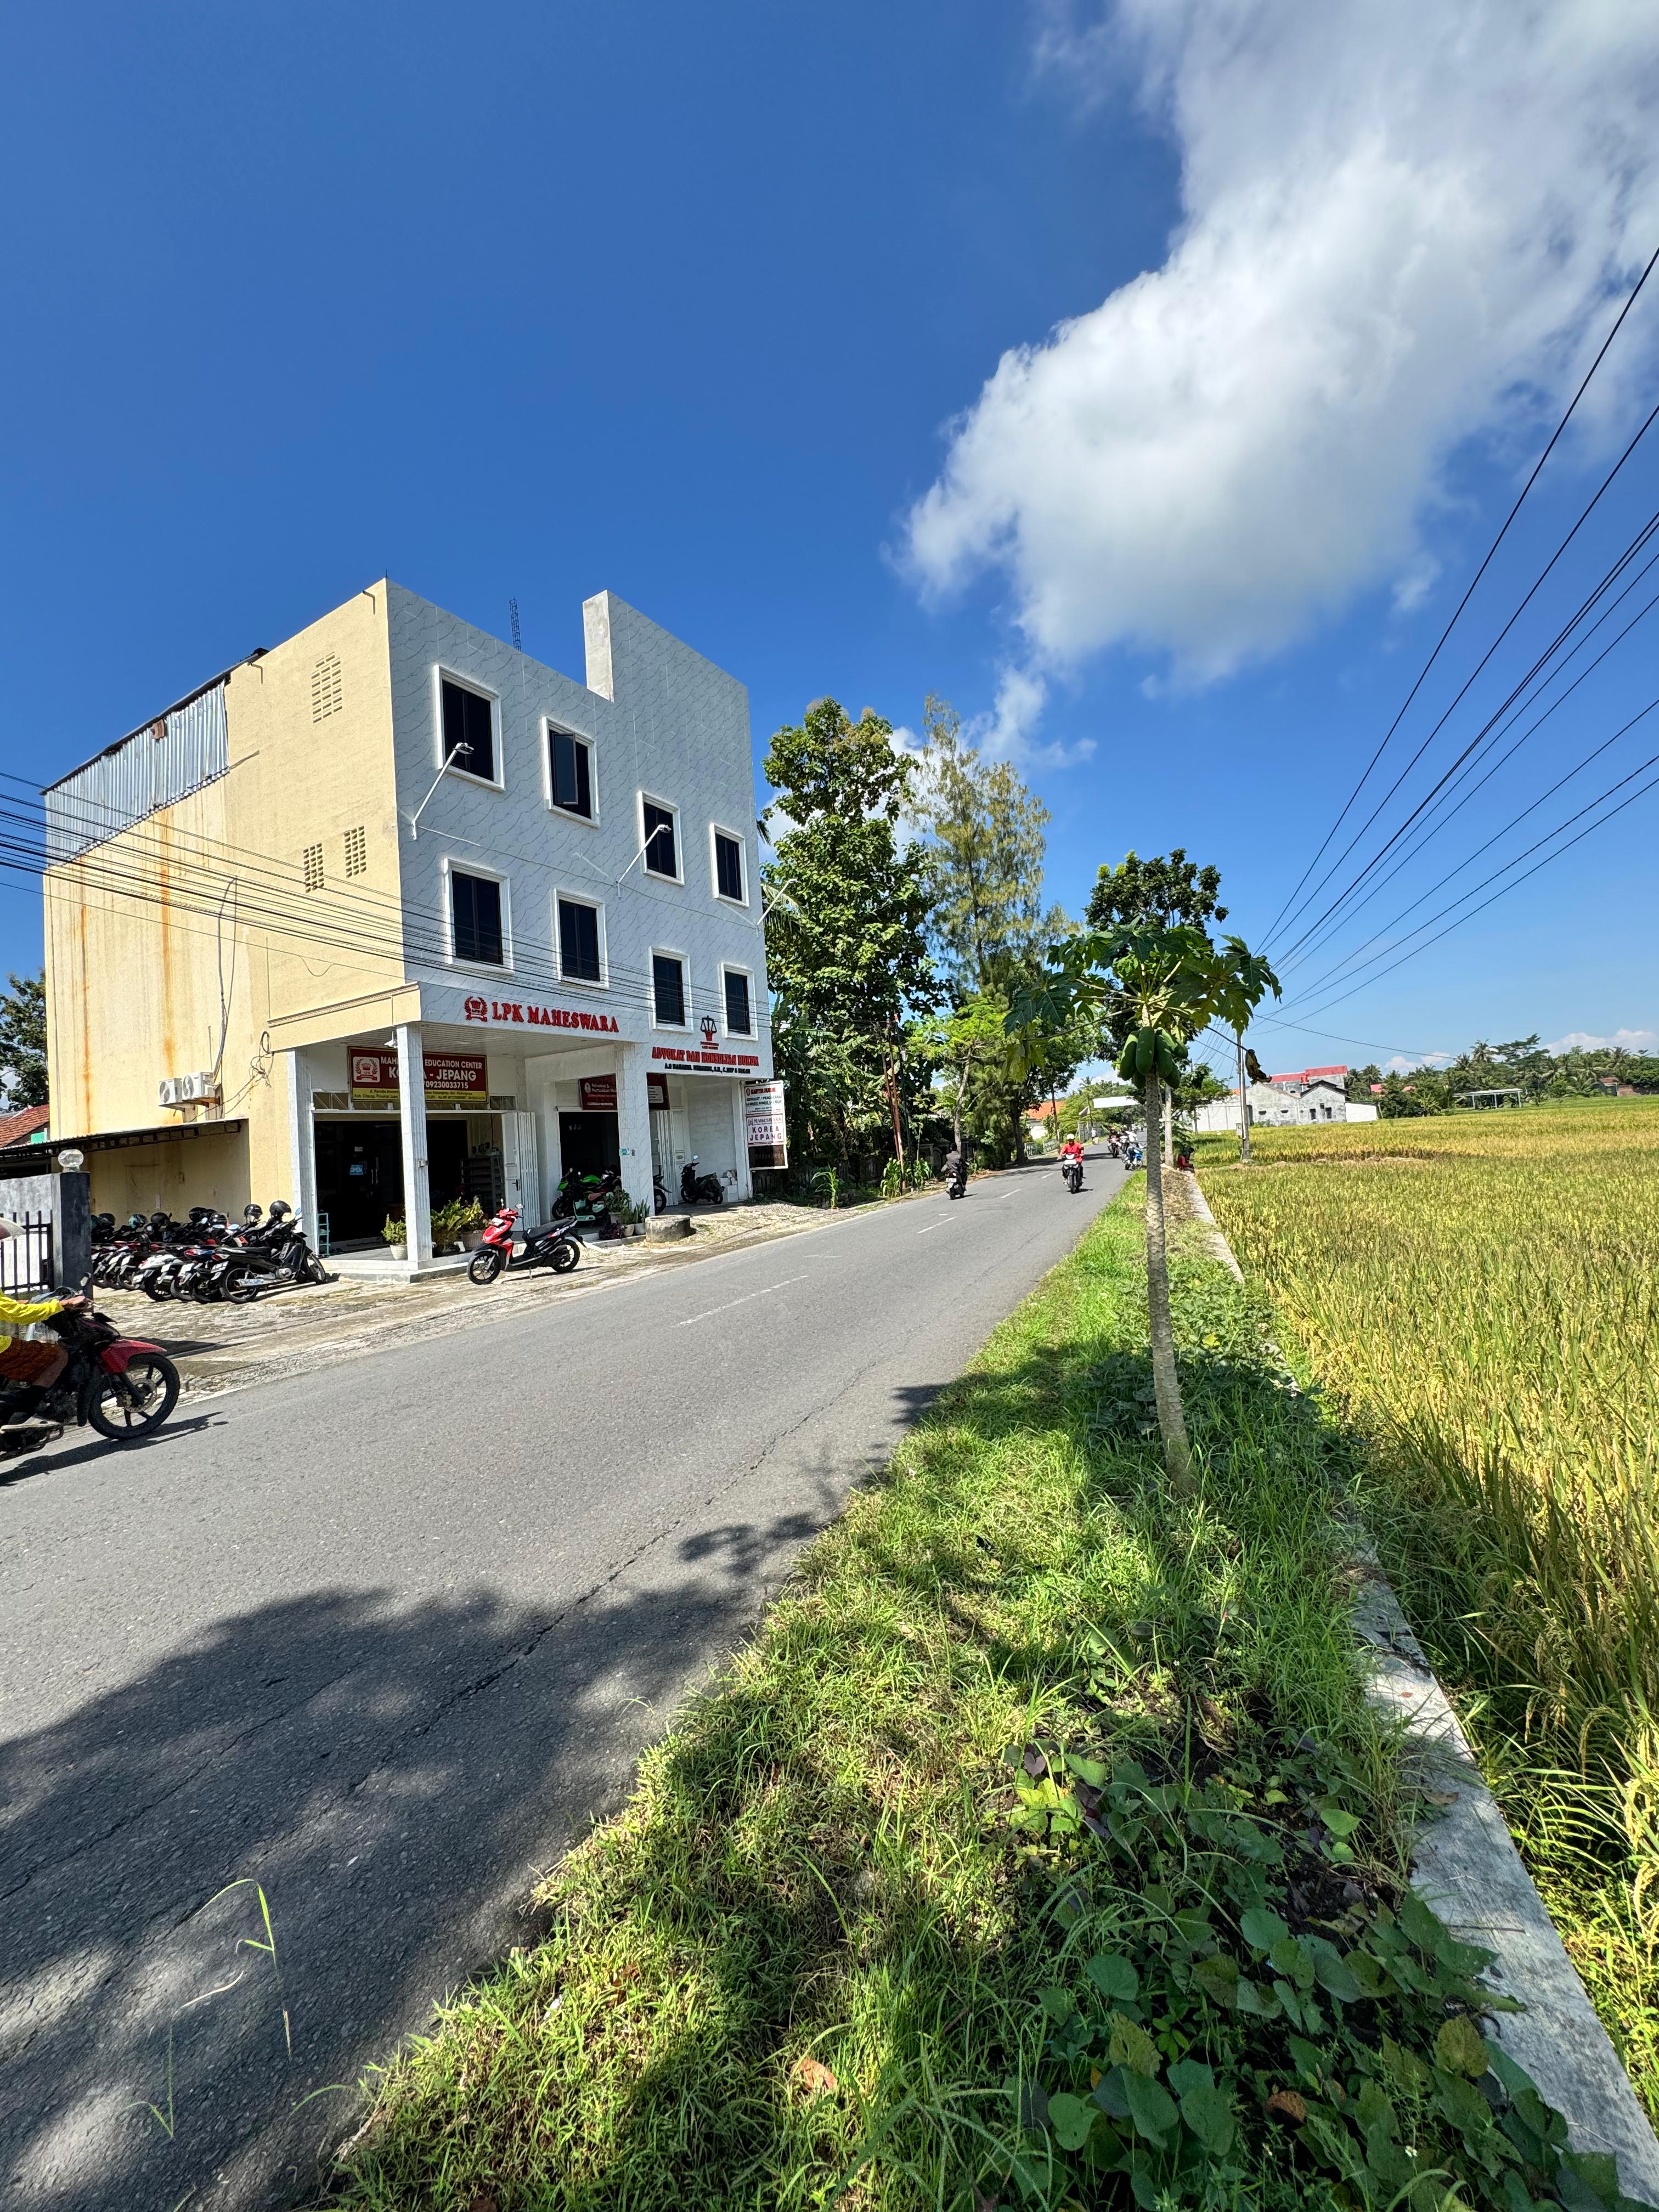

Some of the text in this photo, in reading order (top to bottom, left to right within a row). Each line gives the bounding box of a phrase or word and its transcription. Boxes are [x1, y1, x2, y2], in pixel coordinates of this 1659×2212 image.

[492, 1001, 619, 1032] LPK MAHESWARA
[652, 1047, 685, 1062] ADVOKAT
[686, 1050, 701, 1063] DAN
[425, 1059, 483, 1070] EDUCATION CENTER
[436, 1069, 477, 1081] JEPANG
[424, 1081, 469, 1089] 09230033715
[752, 1125, 780, 1134] KOREA
[750, 1133, 782, 1141] JEPANG
